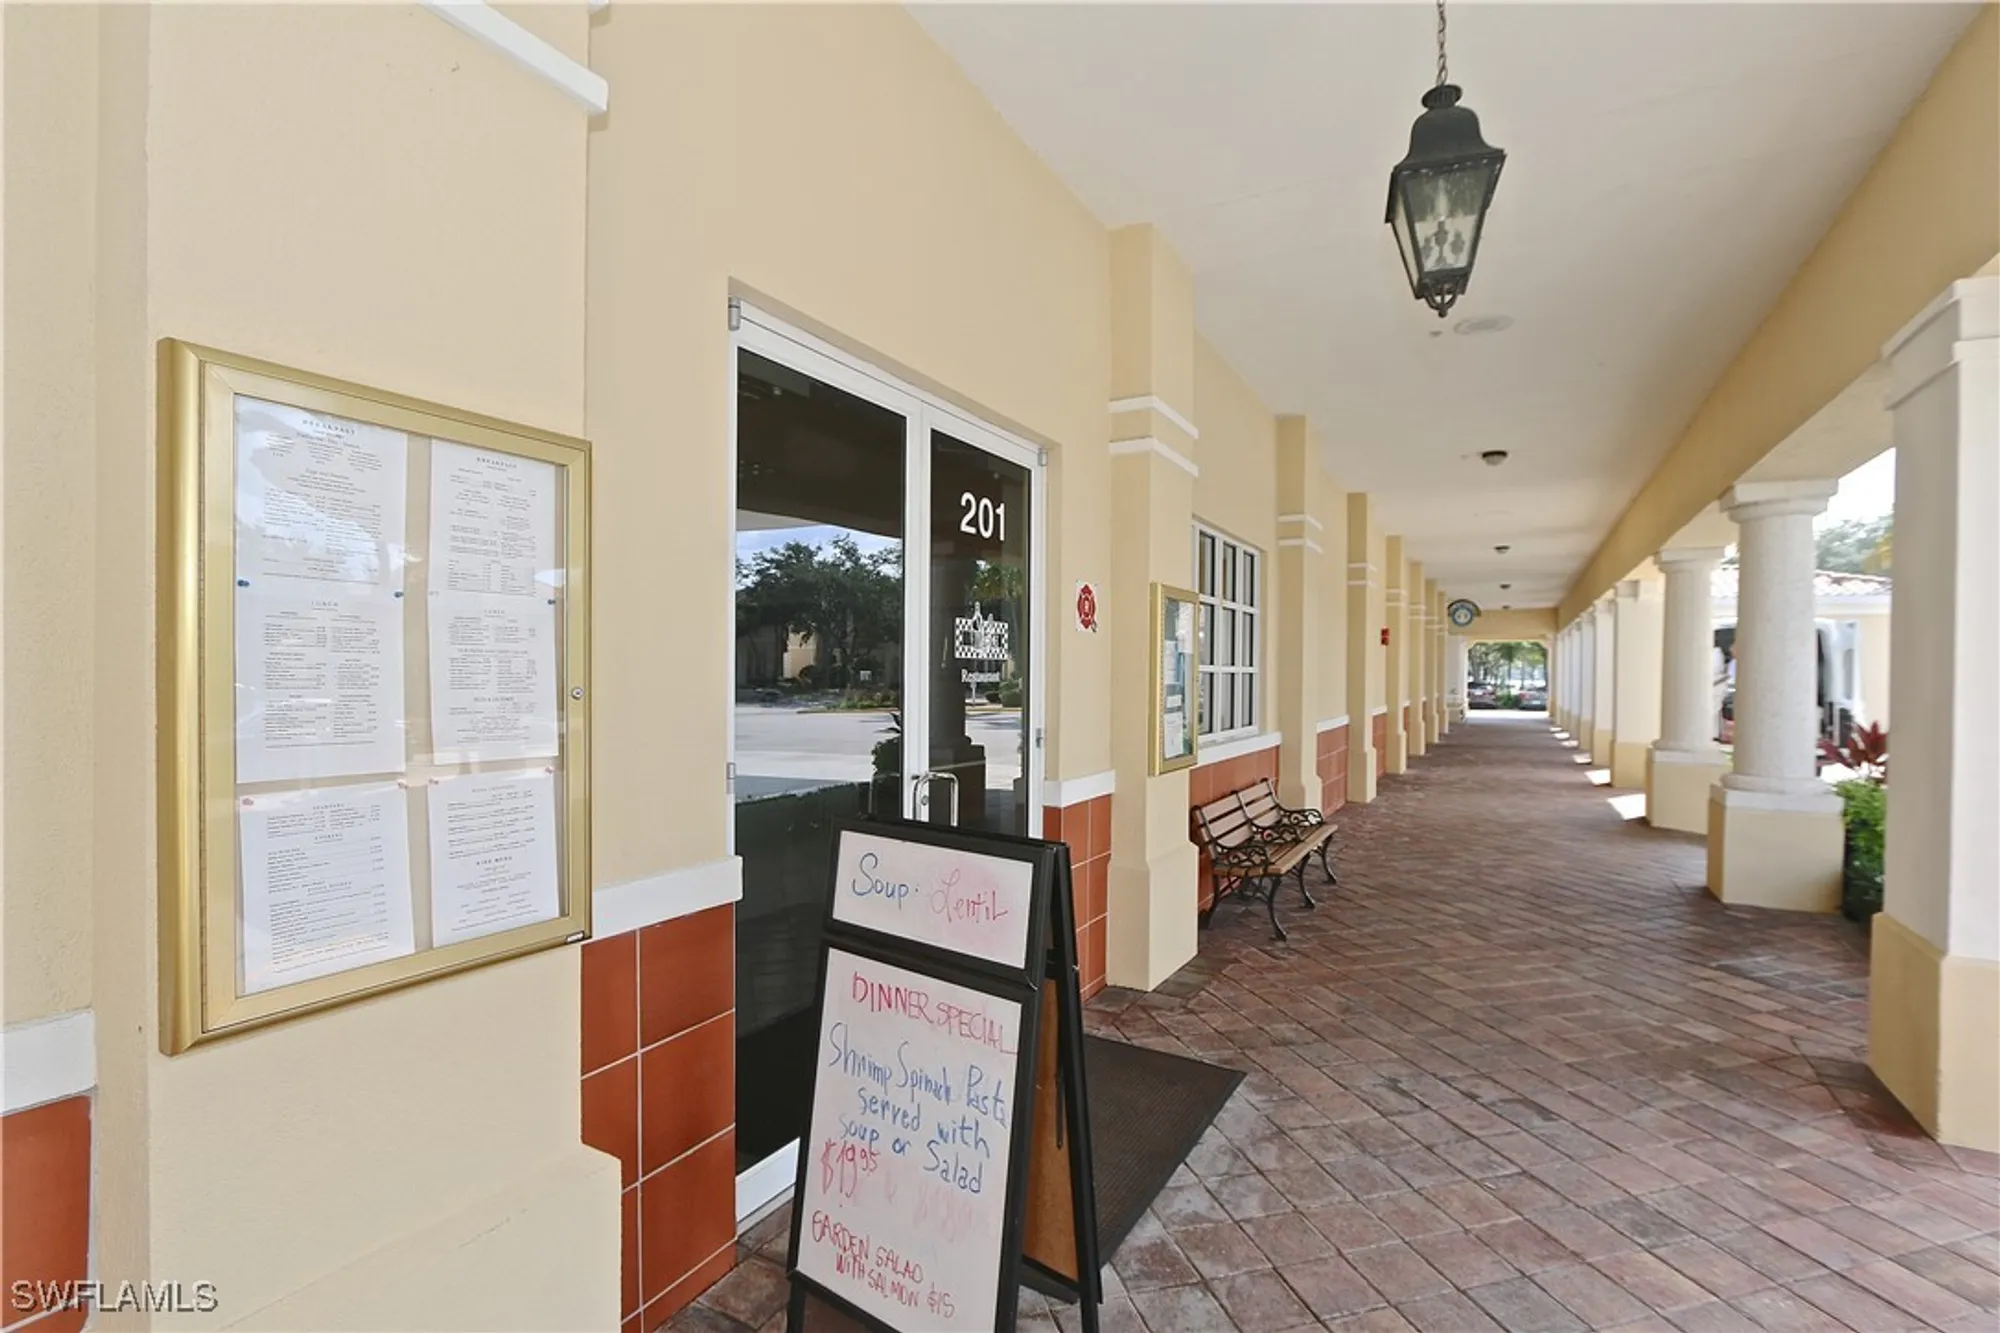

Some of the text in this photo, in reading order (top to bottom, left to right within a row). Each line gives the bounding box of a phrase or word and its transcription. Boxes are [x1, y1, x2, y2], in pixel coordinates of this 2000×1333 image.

[959, 491, 1005, 541] 201
[852, 972, 1019, 1055] DINNER SPECIAL
[936, 1114, 990, 1160] with
[892, 1136, 914, 1156] or
[922, 1139, 983, 1194] Salad
[875, 1246, 924, 1284] SALAD
